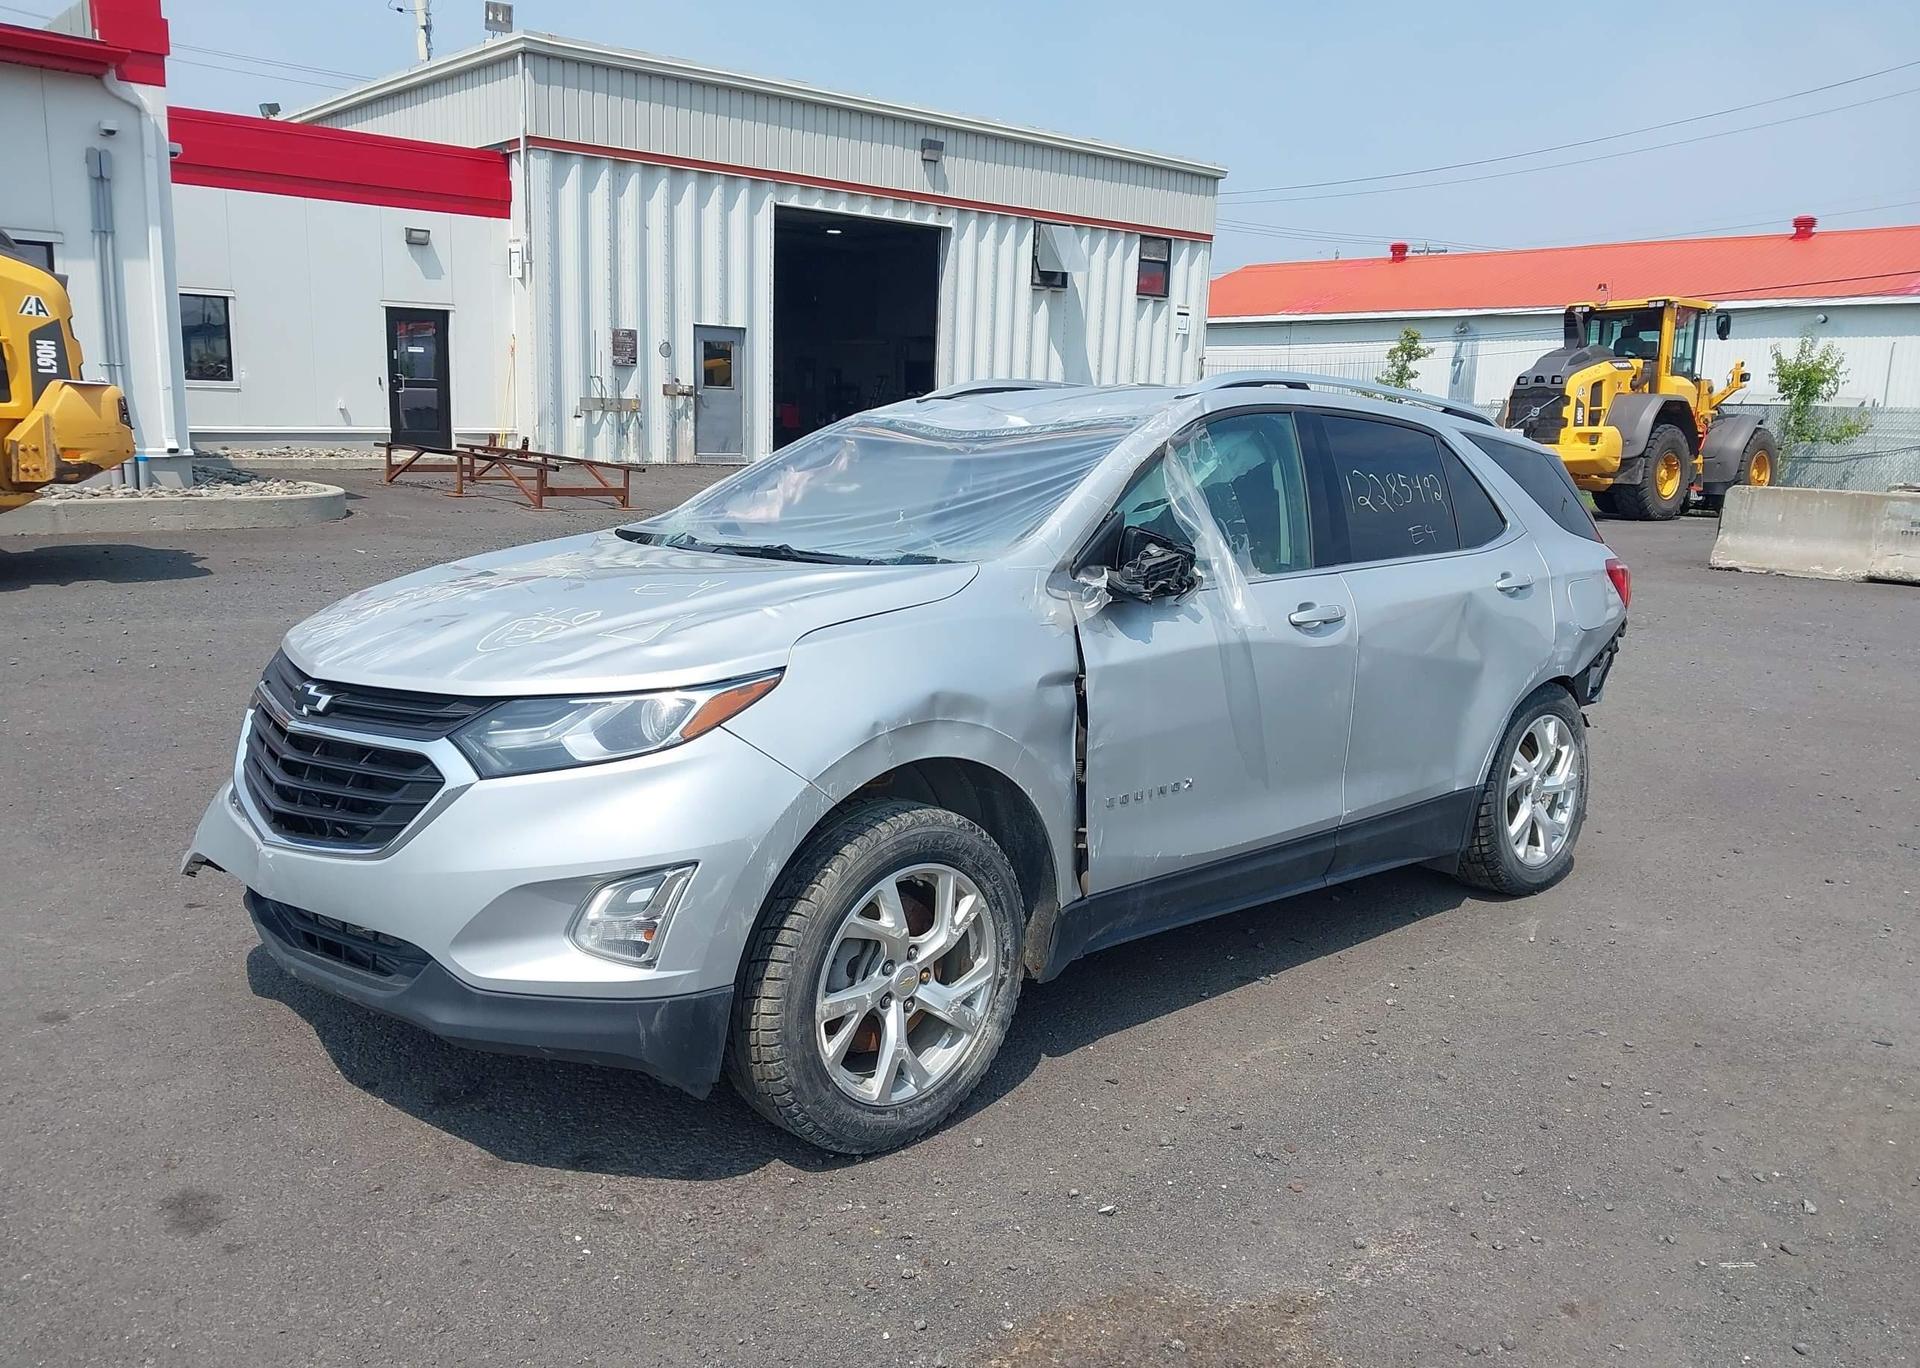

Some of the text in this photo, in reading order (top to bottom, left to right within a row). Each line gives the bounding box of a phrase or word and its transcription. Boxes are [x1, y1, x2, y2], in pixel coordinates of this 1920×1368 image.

[36, 340, 57, 374] L90H
[1345, 469, 1448, 514] 12285492
[1408, 524, 1437, 544] E4
[1105, 777, 1193, 809] EQUINOX
